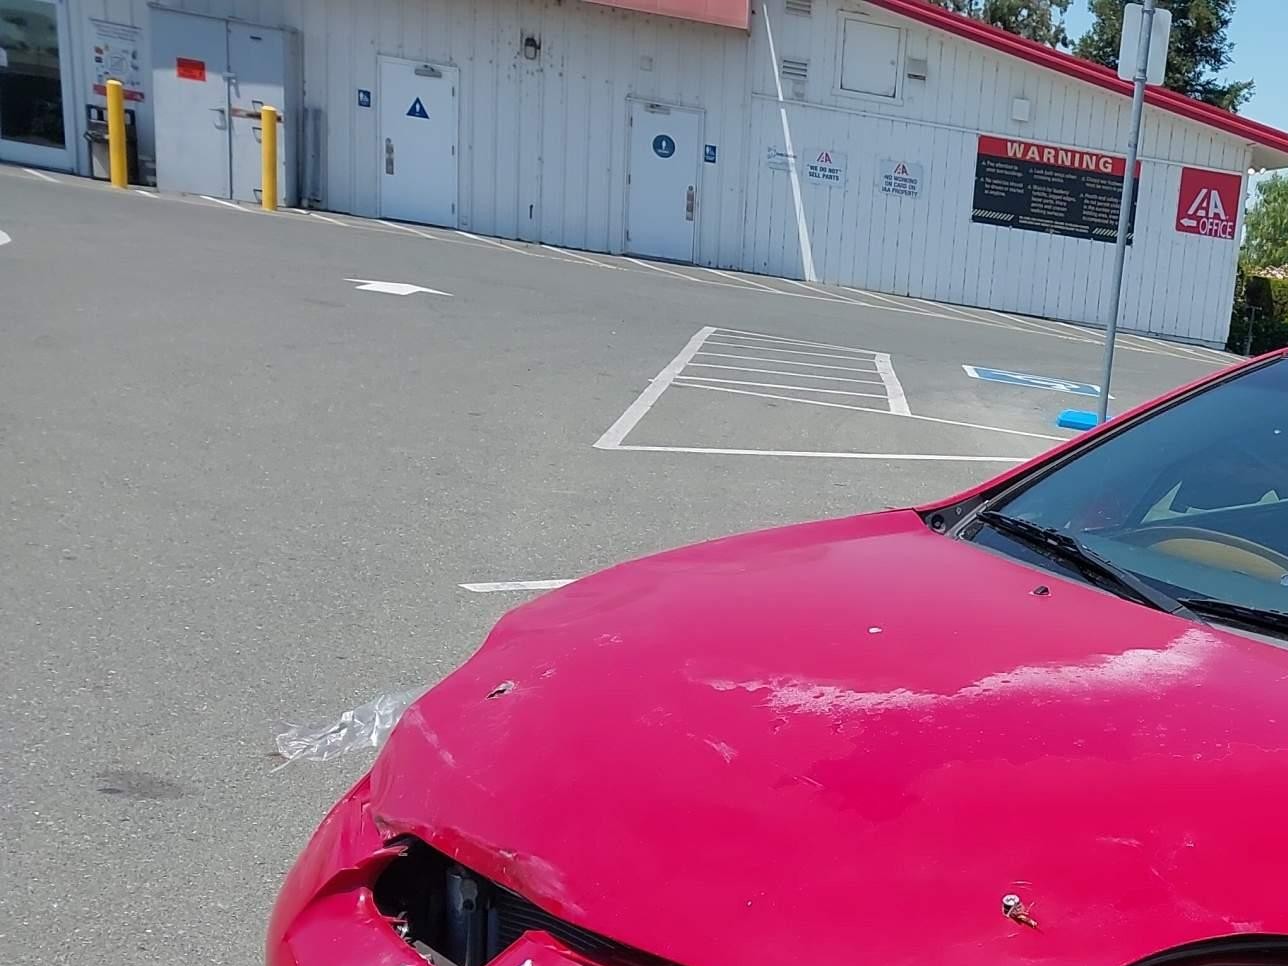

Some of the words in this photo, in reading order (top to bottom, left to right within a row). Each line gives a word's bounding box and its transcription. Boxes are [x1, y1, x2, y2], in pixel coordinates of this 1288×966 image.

[1007, 142, 1113, 173] WARNING
[822, 173, 839, 181] PARTS
[1200, 218, 1234, 239] OFFICE
